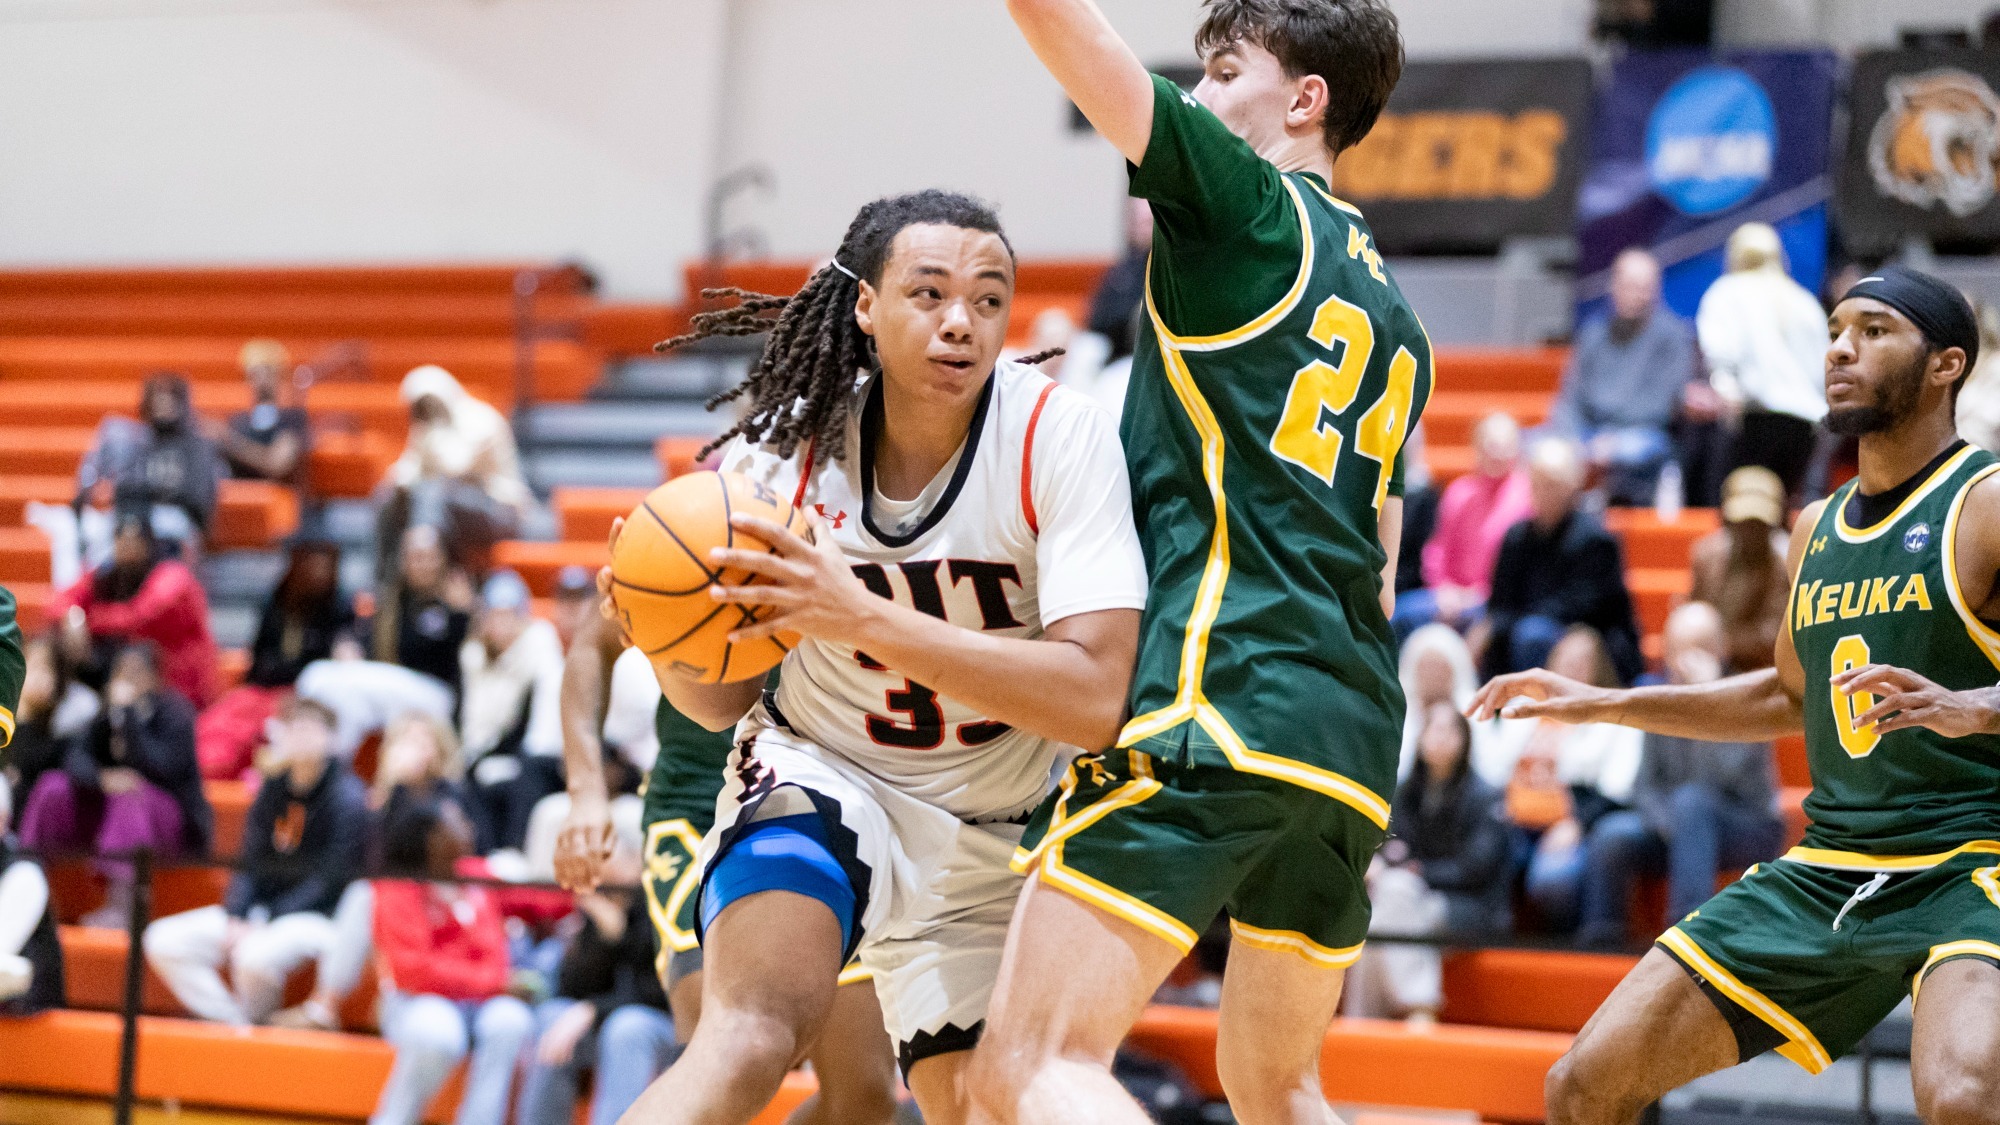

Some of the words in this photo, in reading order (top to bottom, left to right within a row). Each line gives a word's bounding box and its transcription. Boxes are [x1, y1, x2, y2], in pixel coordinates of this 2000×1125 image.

[1347, 223, 1387, 286] KC
[1269, 294, 1417, 522] 24
[1796, 573, 1933, 631] KEUKA
[853, 650, 1018, 751] 3
[1831, 633, 1882, 759] 0
